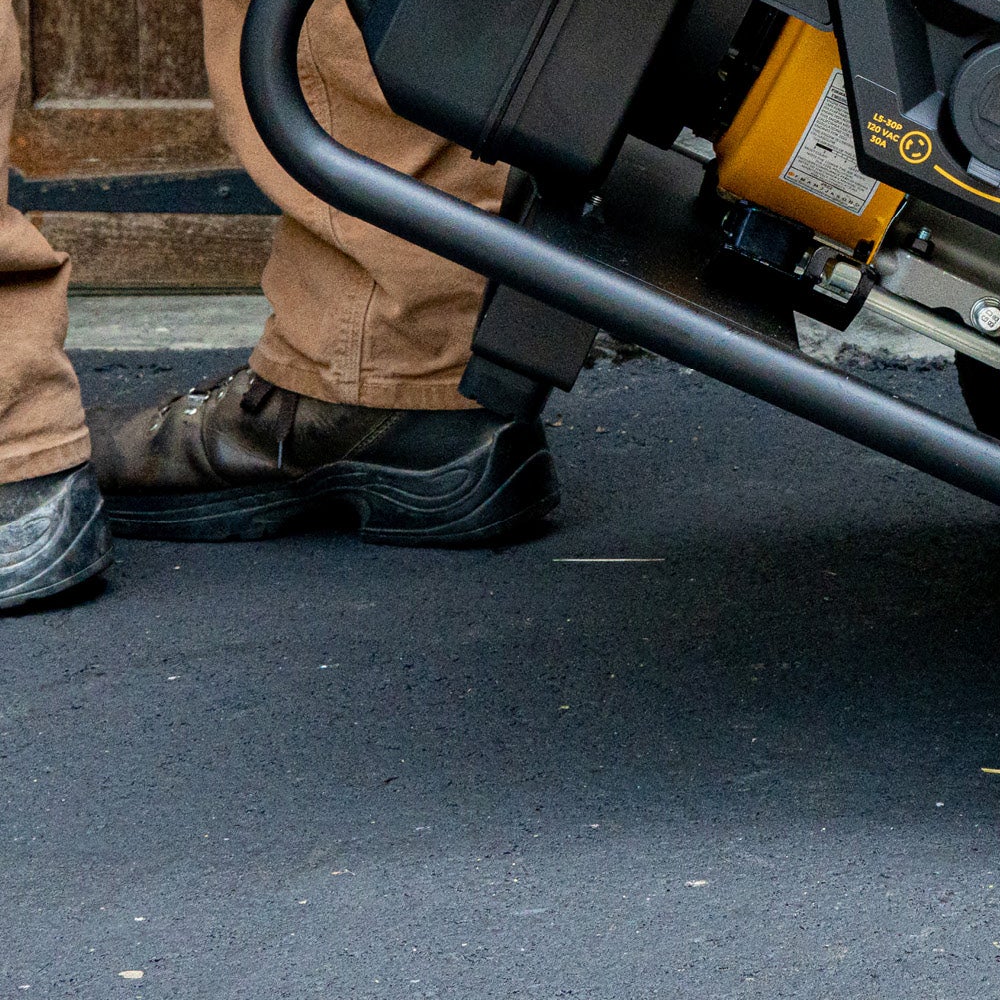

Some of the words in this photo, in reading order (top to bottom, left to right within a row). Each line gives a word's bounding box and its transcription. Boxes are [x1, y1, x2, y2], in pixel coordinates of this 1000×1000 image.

[867, 121, 884, 135] 120
[883, 129, 900, 143] VAC
[869, 135, 887, 149] 30A
